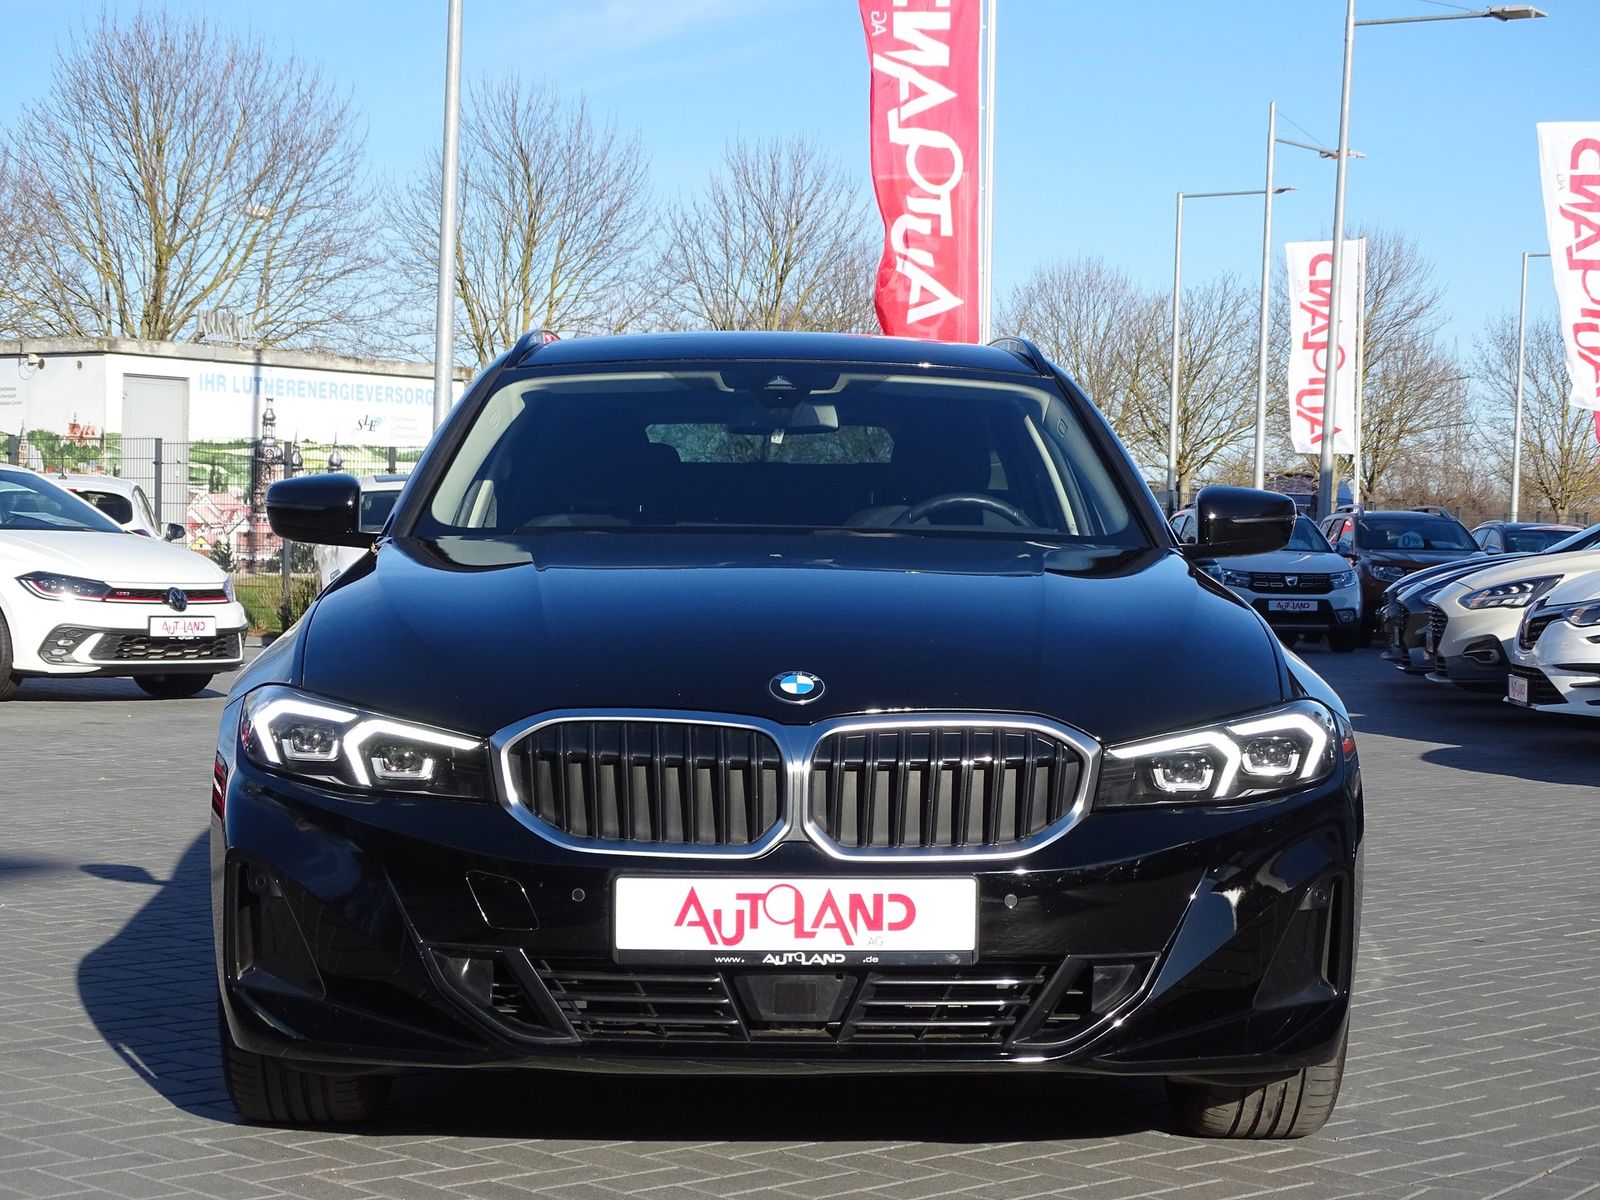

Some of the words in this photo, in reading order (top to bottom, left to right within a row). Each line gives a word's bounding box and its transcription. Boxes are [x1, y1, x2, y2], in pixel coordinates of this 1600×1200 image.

[199, 373, 227, 393] IHR
[674, 884, 917, 946] AUTOLAND
[868, 936, 884, 946] AG
[762, 952, 846, 966] AUTOLAND
[862, 955, 879, 963] .de
